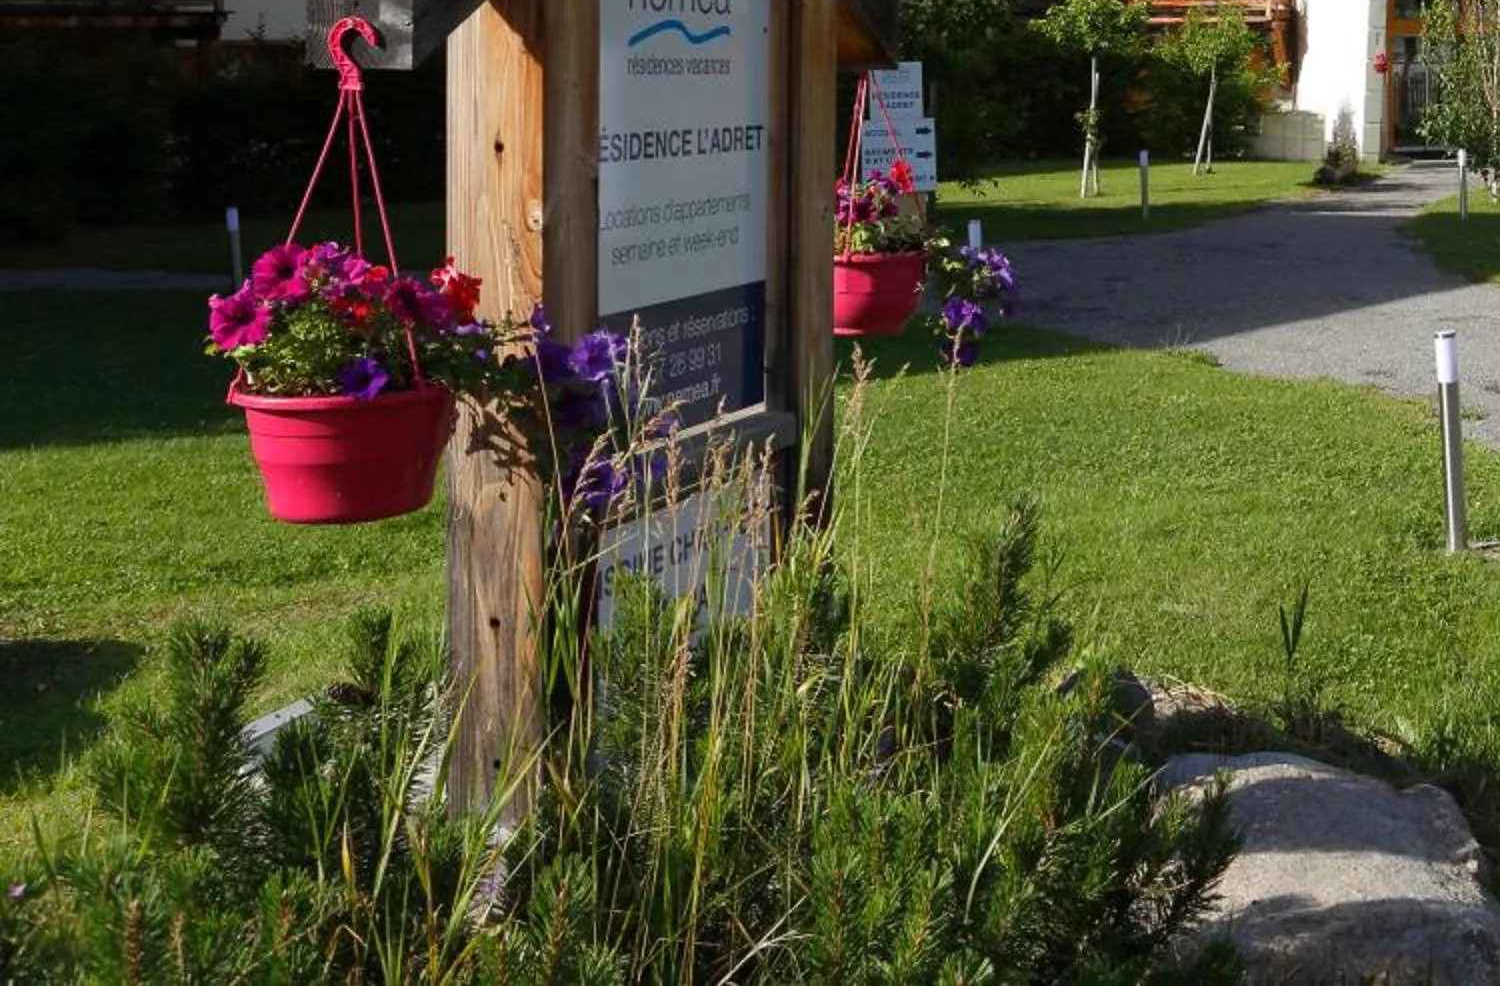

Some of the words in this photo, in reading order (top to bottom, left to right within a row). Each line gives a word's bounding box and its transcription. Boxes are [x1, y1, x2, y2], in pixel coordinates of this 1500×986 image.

[598, 125, 692, 164] ÉSIDENCE
[697, 124, 764, 156] L'ADRET
[611, 236, 665, 266] semaine
[668, 233, 681, 256] et
